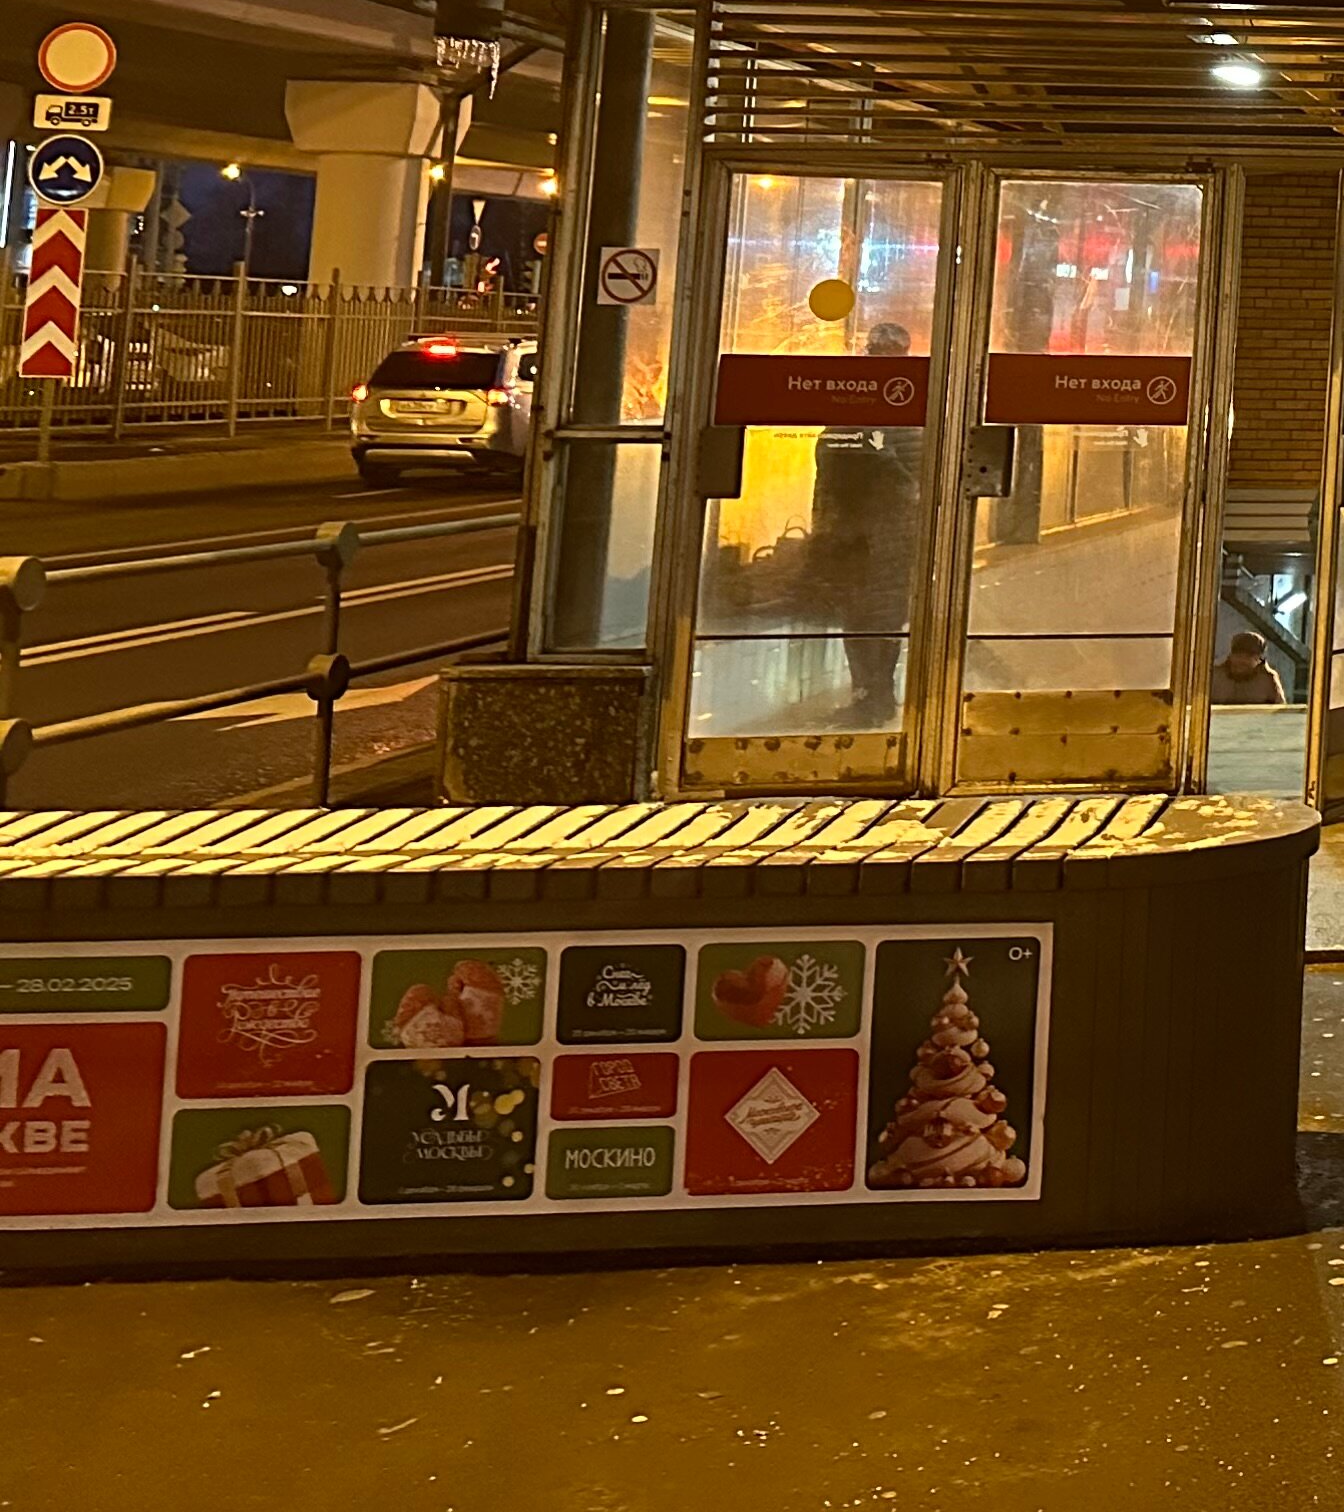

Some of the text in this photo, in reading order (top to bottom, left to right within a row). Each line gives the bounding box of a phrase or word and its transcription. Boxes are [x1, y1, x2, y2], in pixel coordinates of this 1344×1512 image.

[787, 375, 878, 392] Нет входа
[1055, 375, 1142, 391] Нет входа
[15, 976, 134, 993] 28.02.2025
[564, 1147, 657, 1171] МОСКИНО
